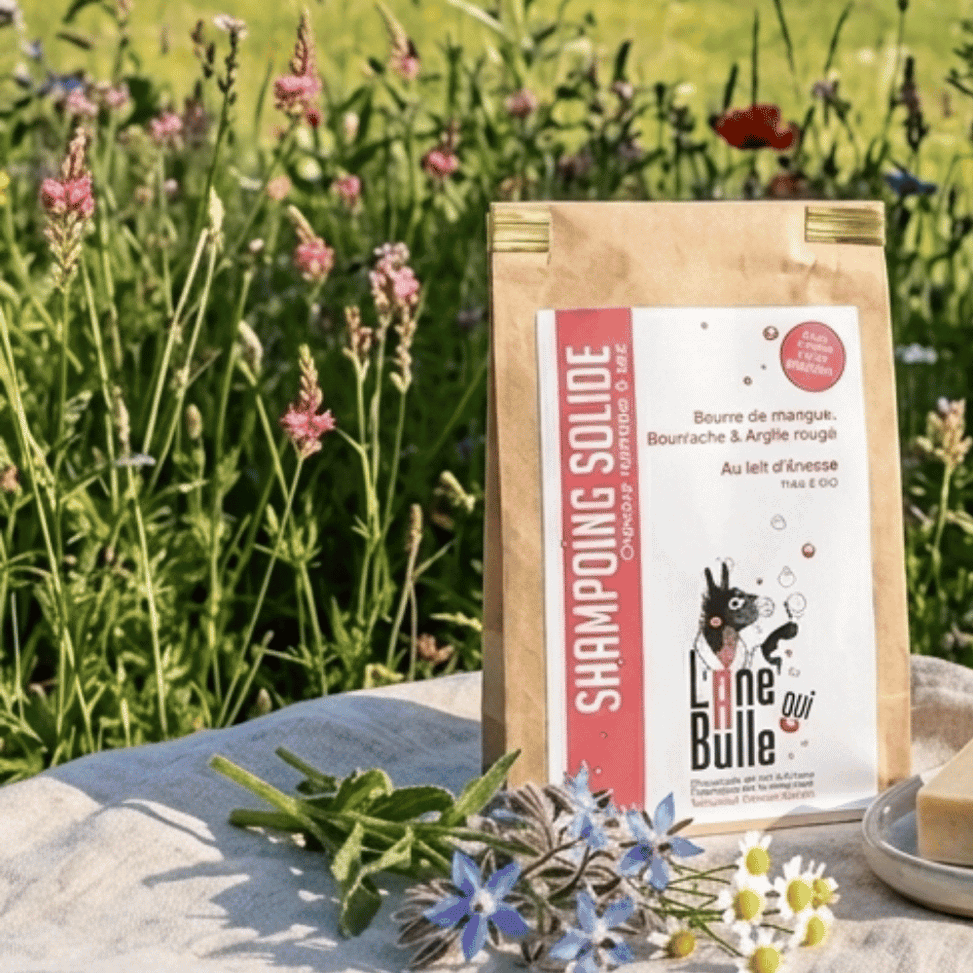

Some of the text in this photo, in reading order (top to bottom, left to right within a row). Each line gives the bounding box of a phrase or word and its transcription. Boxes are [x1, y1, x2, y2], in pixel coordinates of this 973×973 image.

[748, 409, 767, 423] de
[721, 461, 741, 475] Au
[566, 346, 622, 714] SHAMPOING SOLIDE
[690, 709, 776, 770] Bulle
